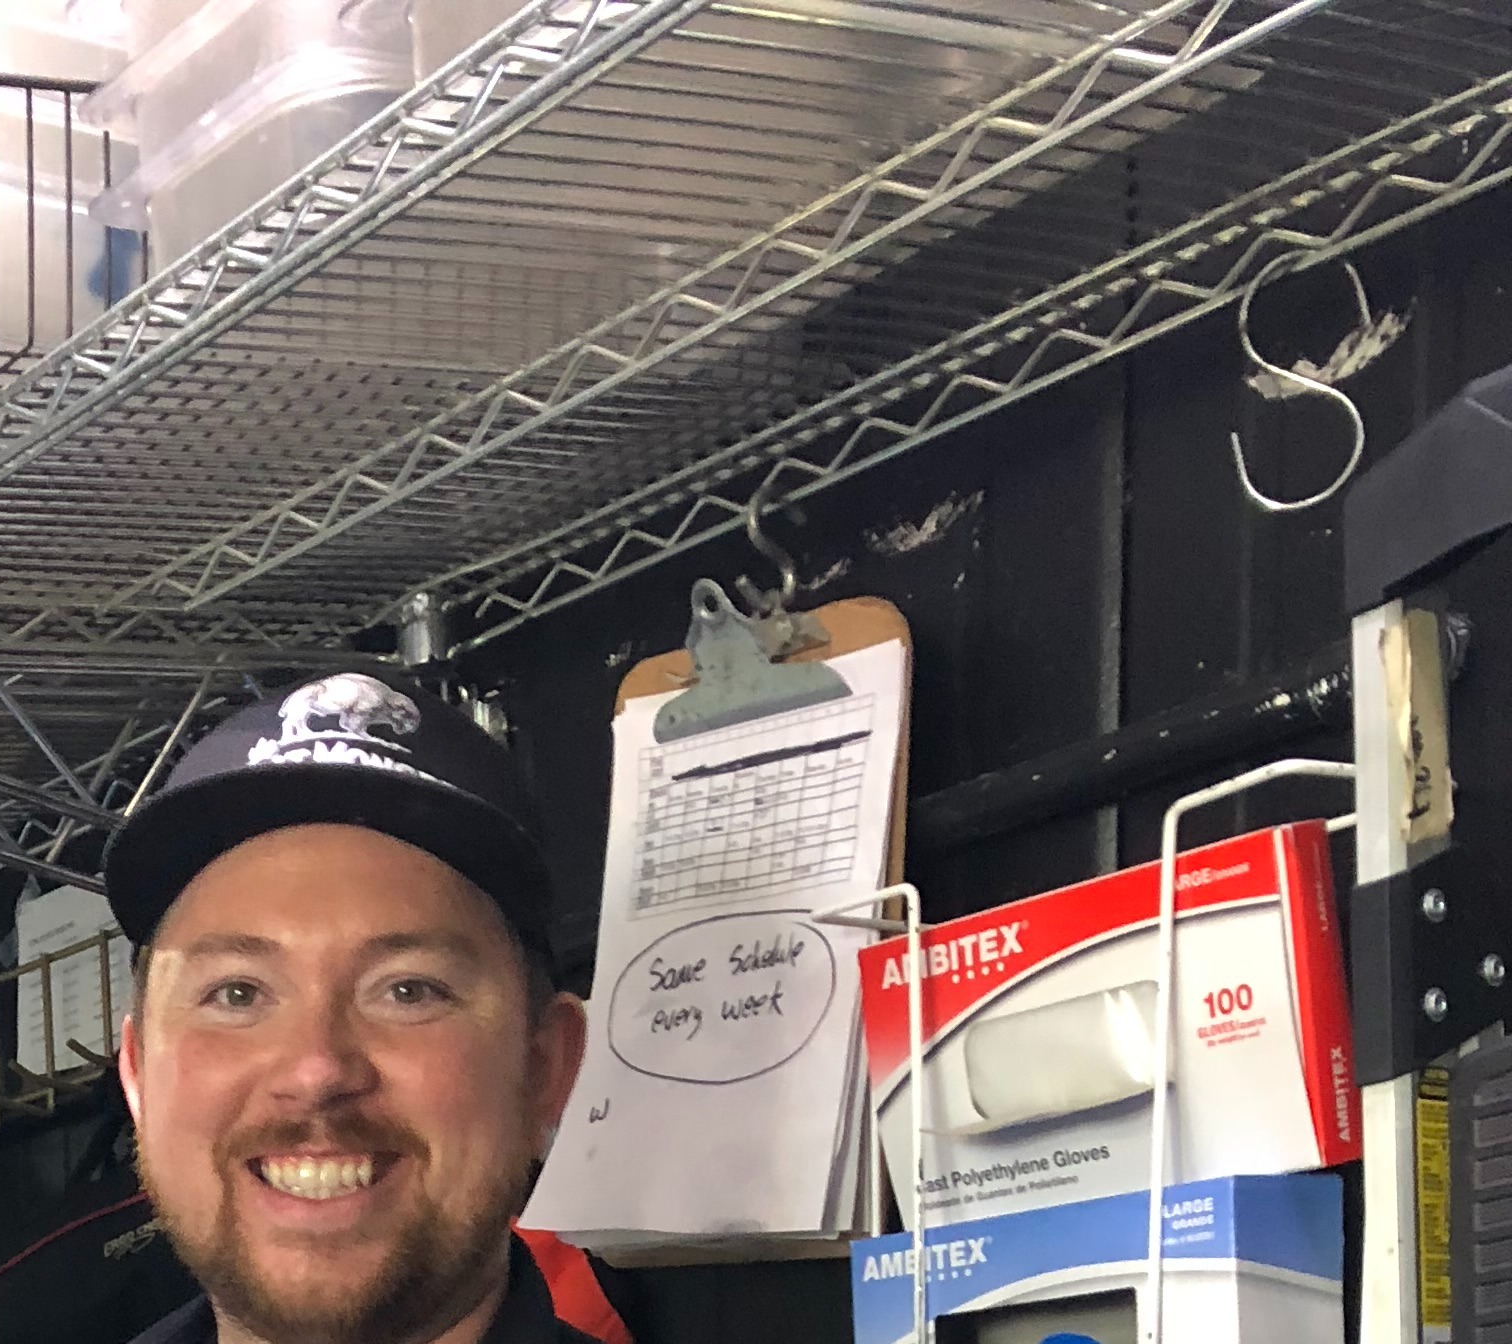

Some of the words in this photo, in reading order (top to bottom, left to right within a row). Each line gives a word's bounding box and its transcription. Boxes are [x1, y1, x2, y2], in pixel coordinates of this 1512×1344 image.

[1203, 983, 1254, 1018] 100
[650, 1004, 704, 1041] every
[1330, 1045, 1351, 1143] AMBITEX
[950, 1158, 1050, 1188] Polyethylene
[1053, 1145, 1111, 1168] Gloves
